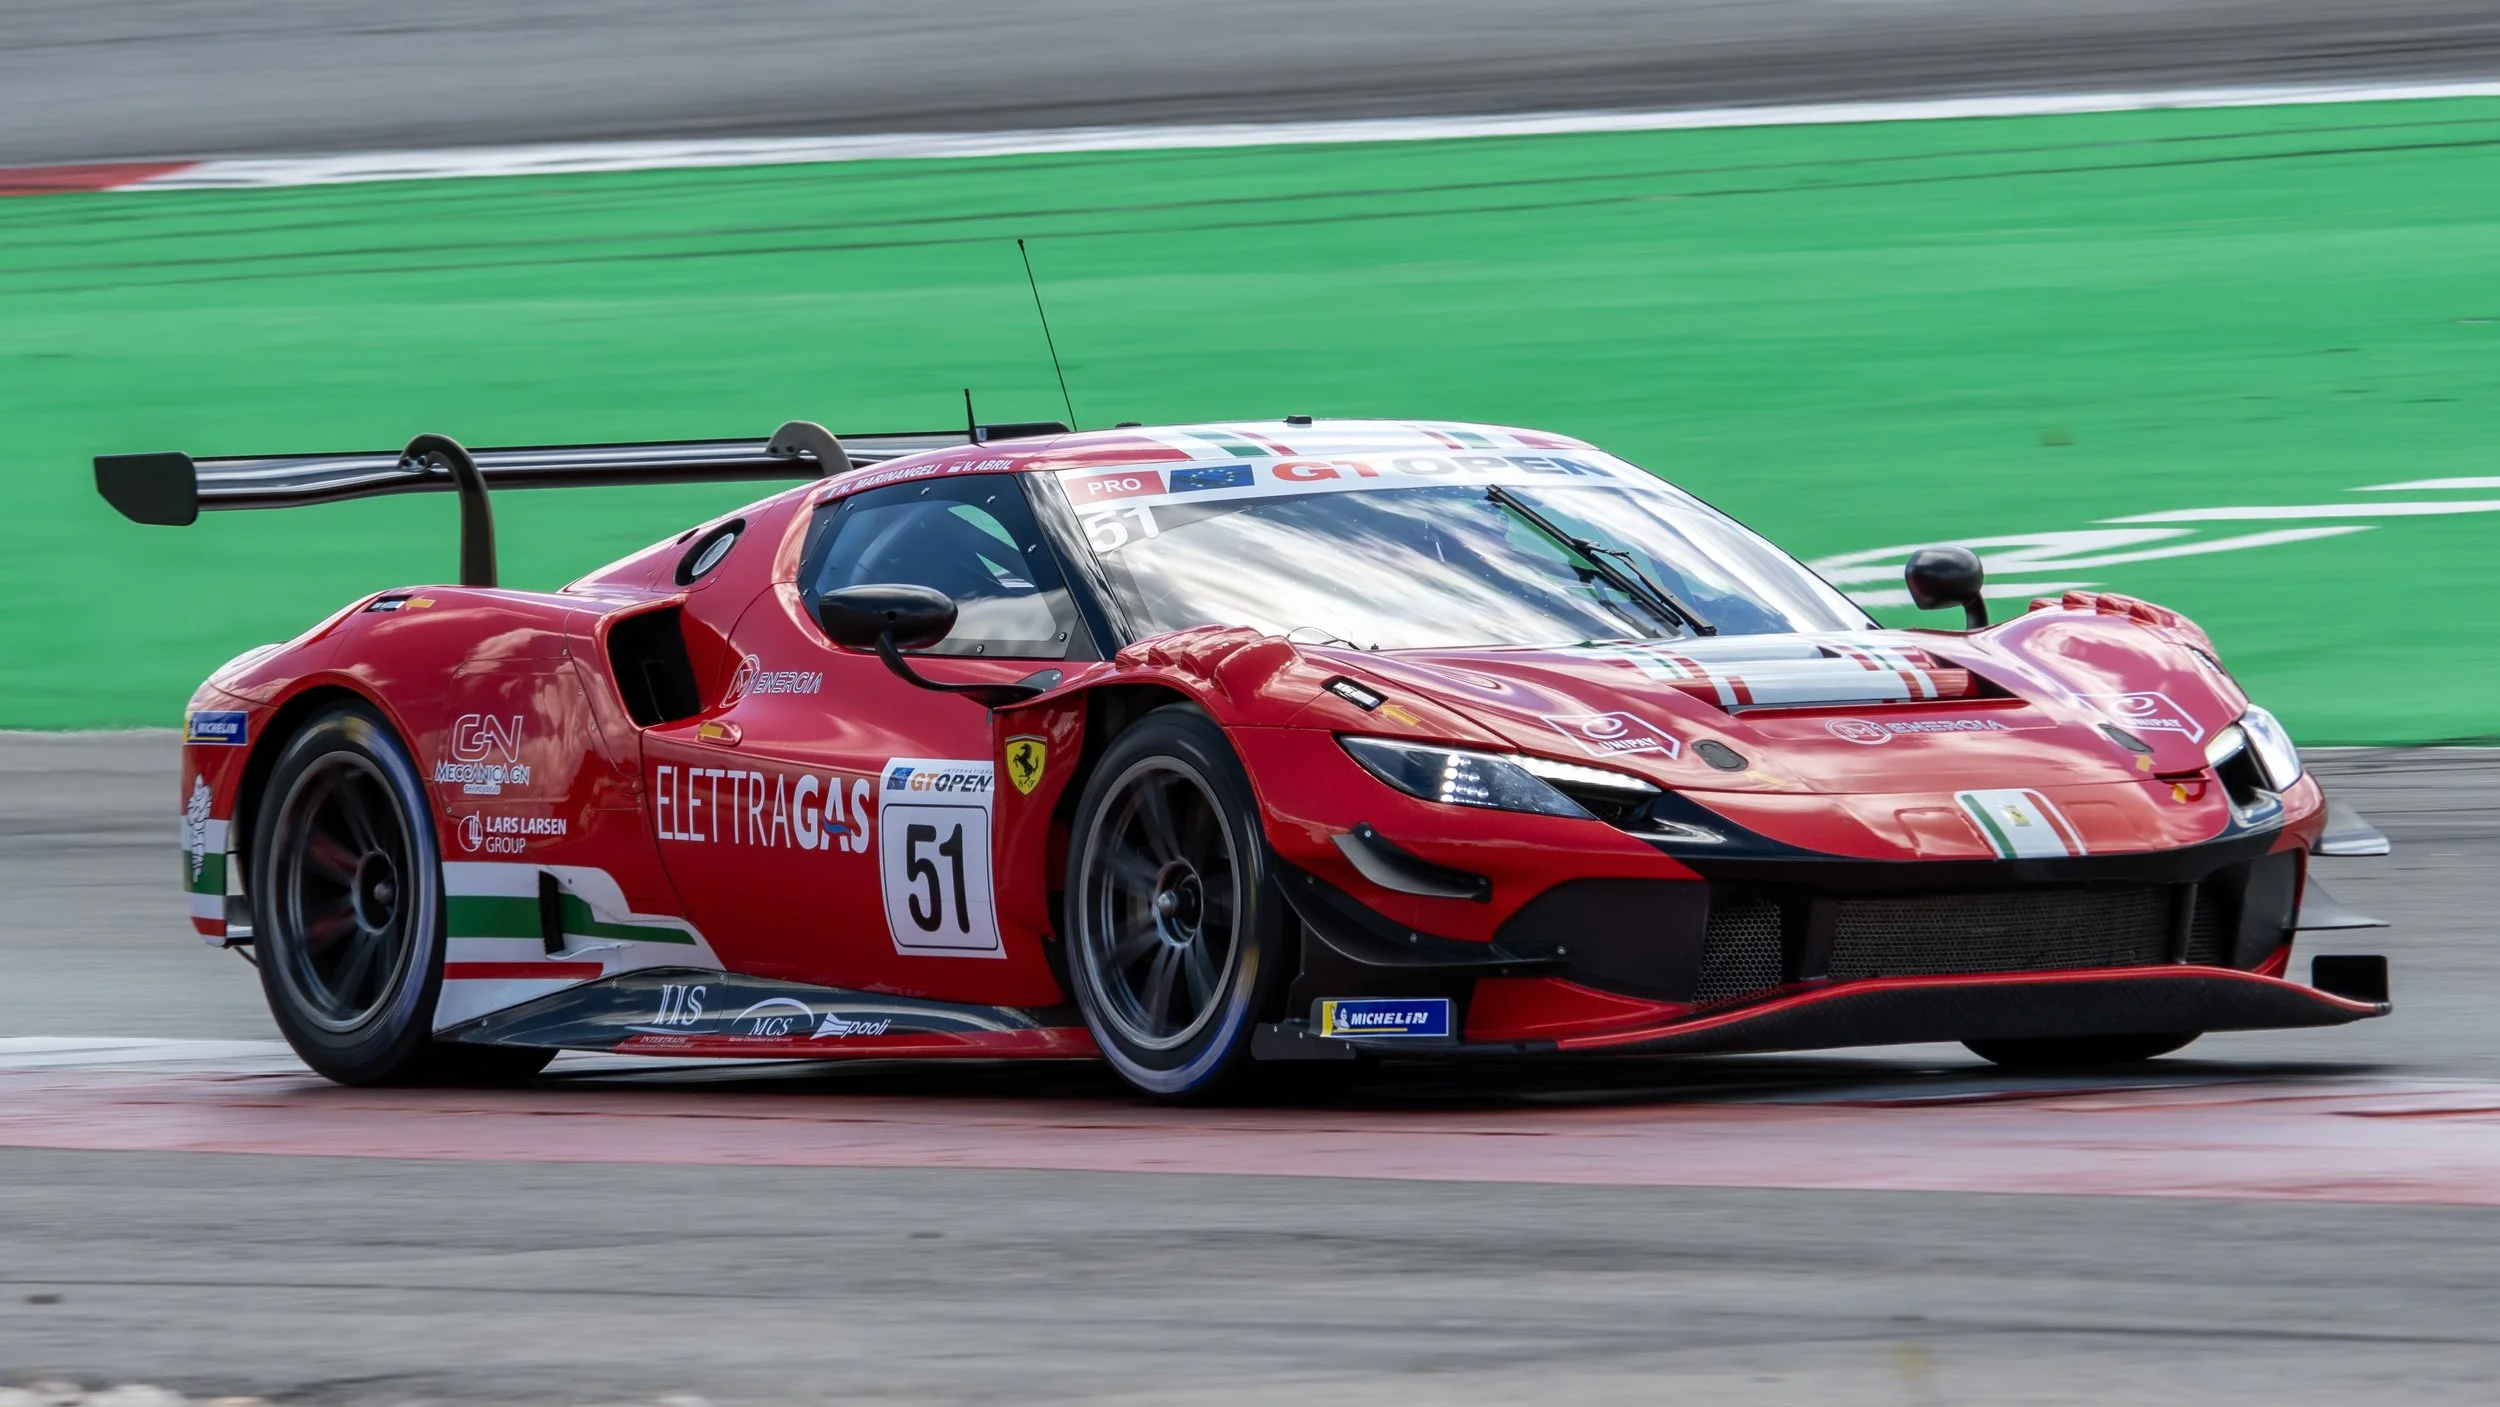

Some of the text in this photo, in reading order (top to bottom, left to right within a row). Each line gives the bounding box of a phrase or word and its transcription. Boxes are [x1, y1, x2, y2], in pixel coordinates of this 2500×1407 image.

[961, 460, 1014, 472] V. ABRIL
[853, 464, 942, 490] MARINANGELI
[1087, 478, 1142, 496] PRO
[1082, 505, 1160, 553] 51
[753, 671, 823, 694] ENERGIA
[1885, 719, 2014, 734] ENERGIA
[452, 714, 523, 763] GN
[1599, 737, 1657, 750] UNIPAY
[435, 759, 531, 787] MECCANICA GN
[656, 765, 871, 854] ELETTRAGAS
[486, 816, 567, 835] LARS LARSEN
[485, 837, 526, 853] GROUP
[905, 823, 971, 934] 51
[748, 1017, 794, 1037] MCS
[841, 1018, 892, 1039] paoli
[1351, 1012, 1429, 1025] MICHELIN
